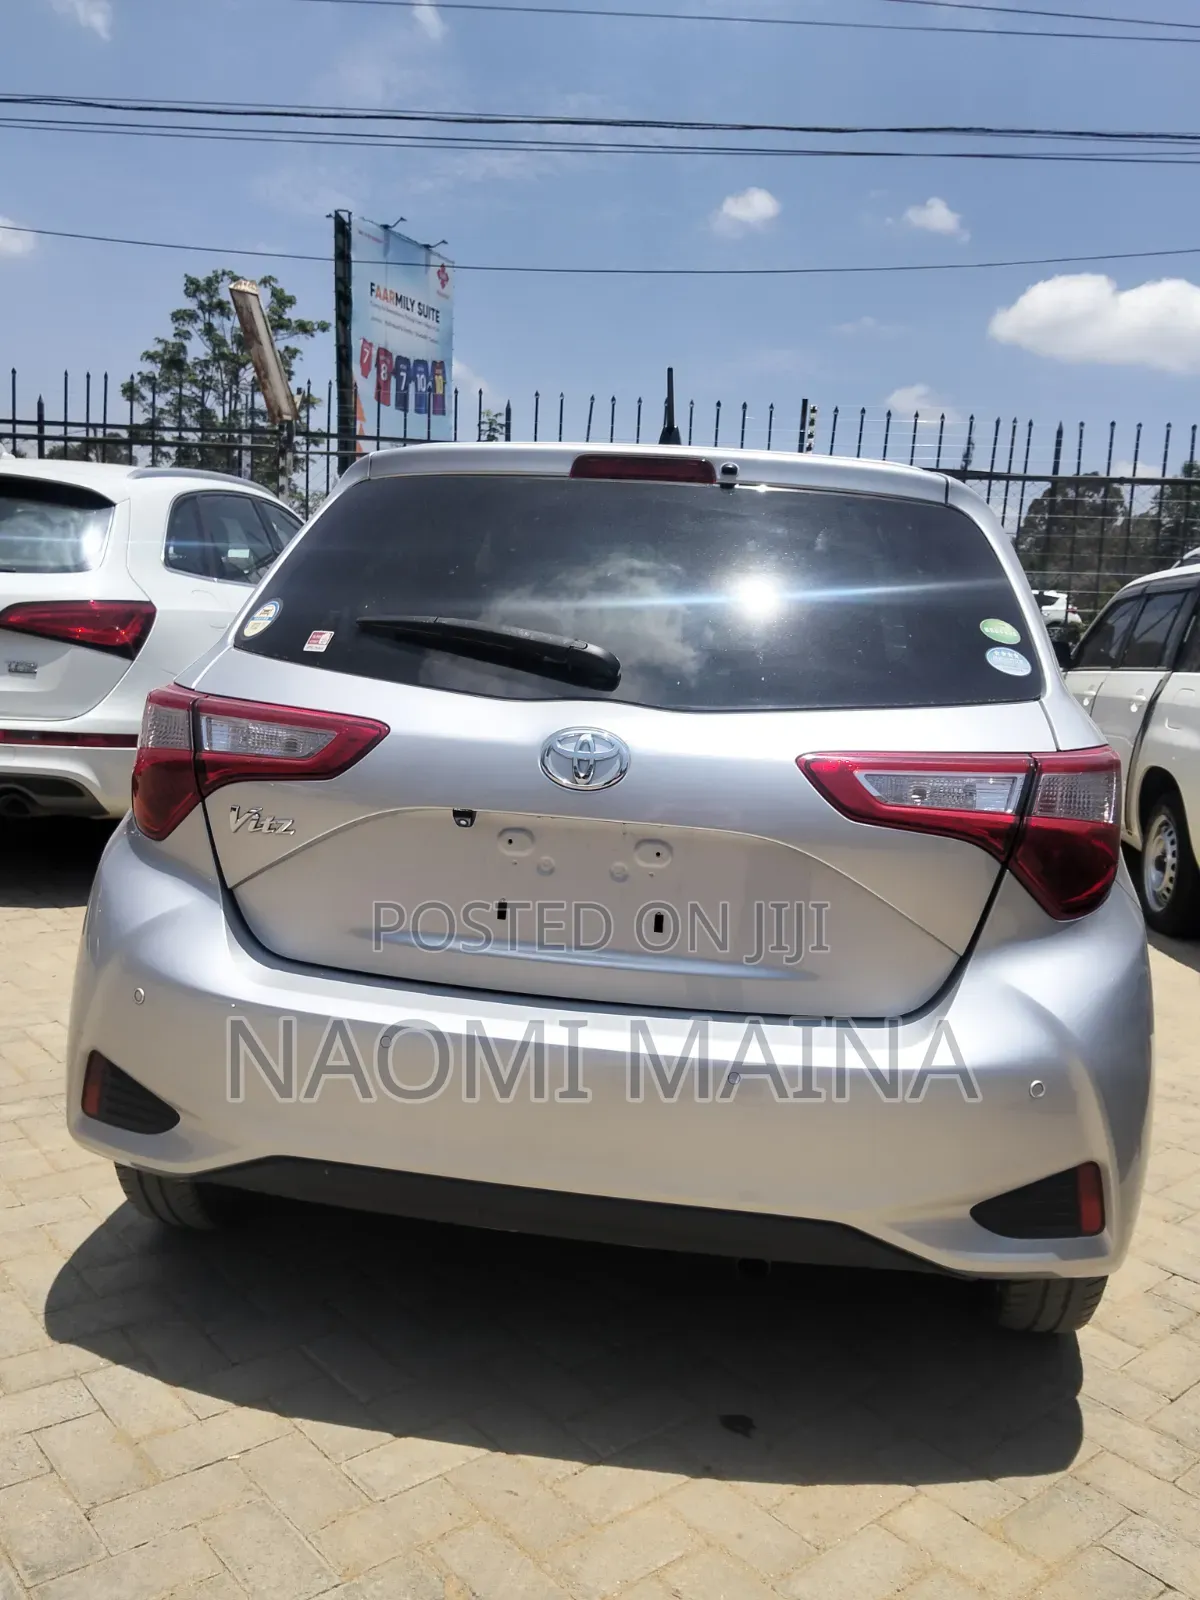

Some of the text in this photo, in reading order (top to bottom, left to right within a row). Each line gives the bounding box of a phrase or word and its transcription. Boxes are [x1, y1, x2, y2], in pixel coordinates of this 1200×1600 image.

[370, 282, 415, 313] FAARMILY
[417, 302, 440, 323] SUITE
[363, 348, 370, 363] 7
[380, 363, 388, 381] 8
[400, 371, 407, 391] 7
[416, 373, 427, 392] 10
[230, 805, 296, 835] Vitz
